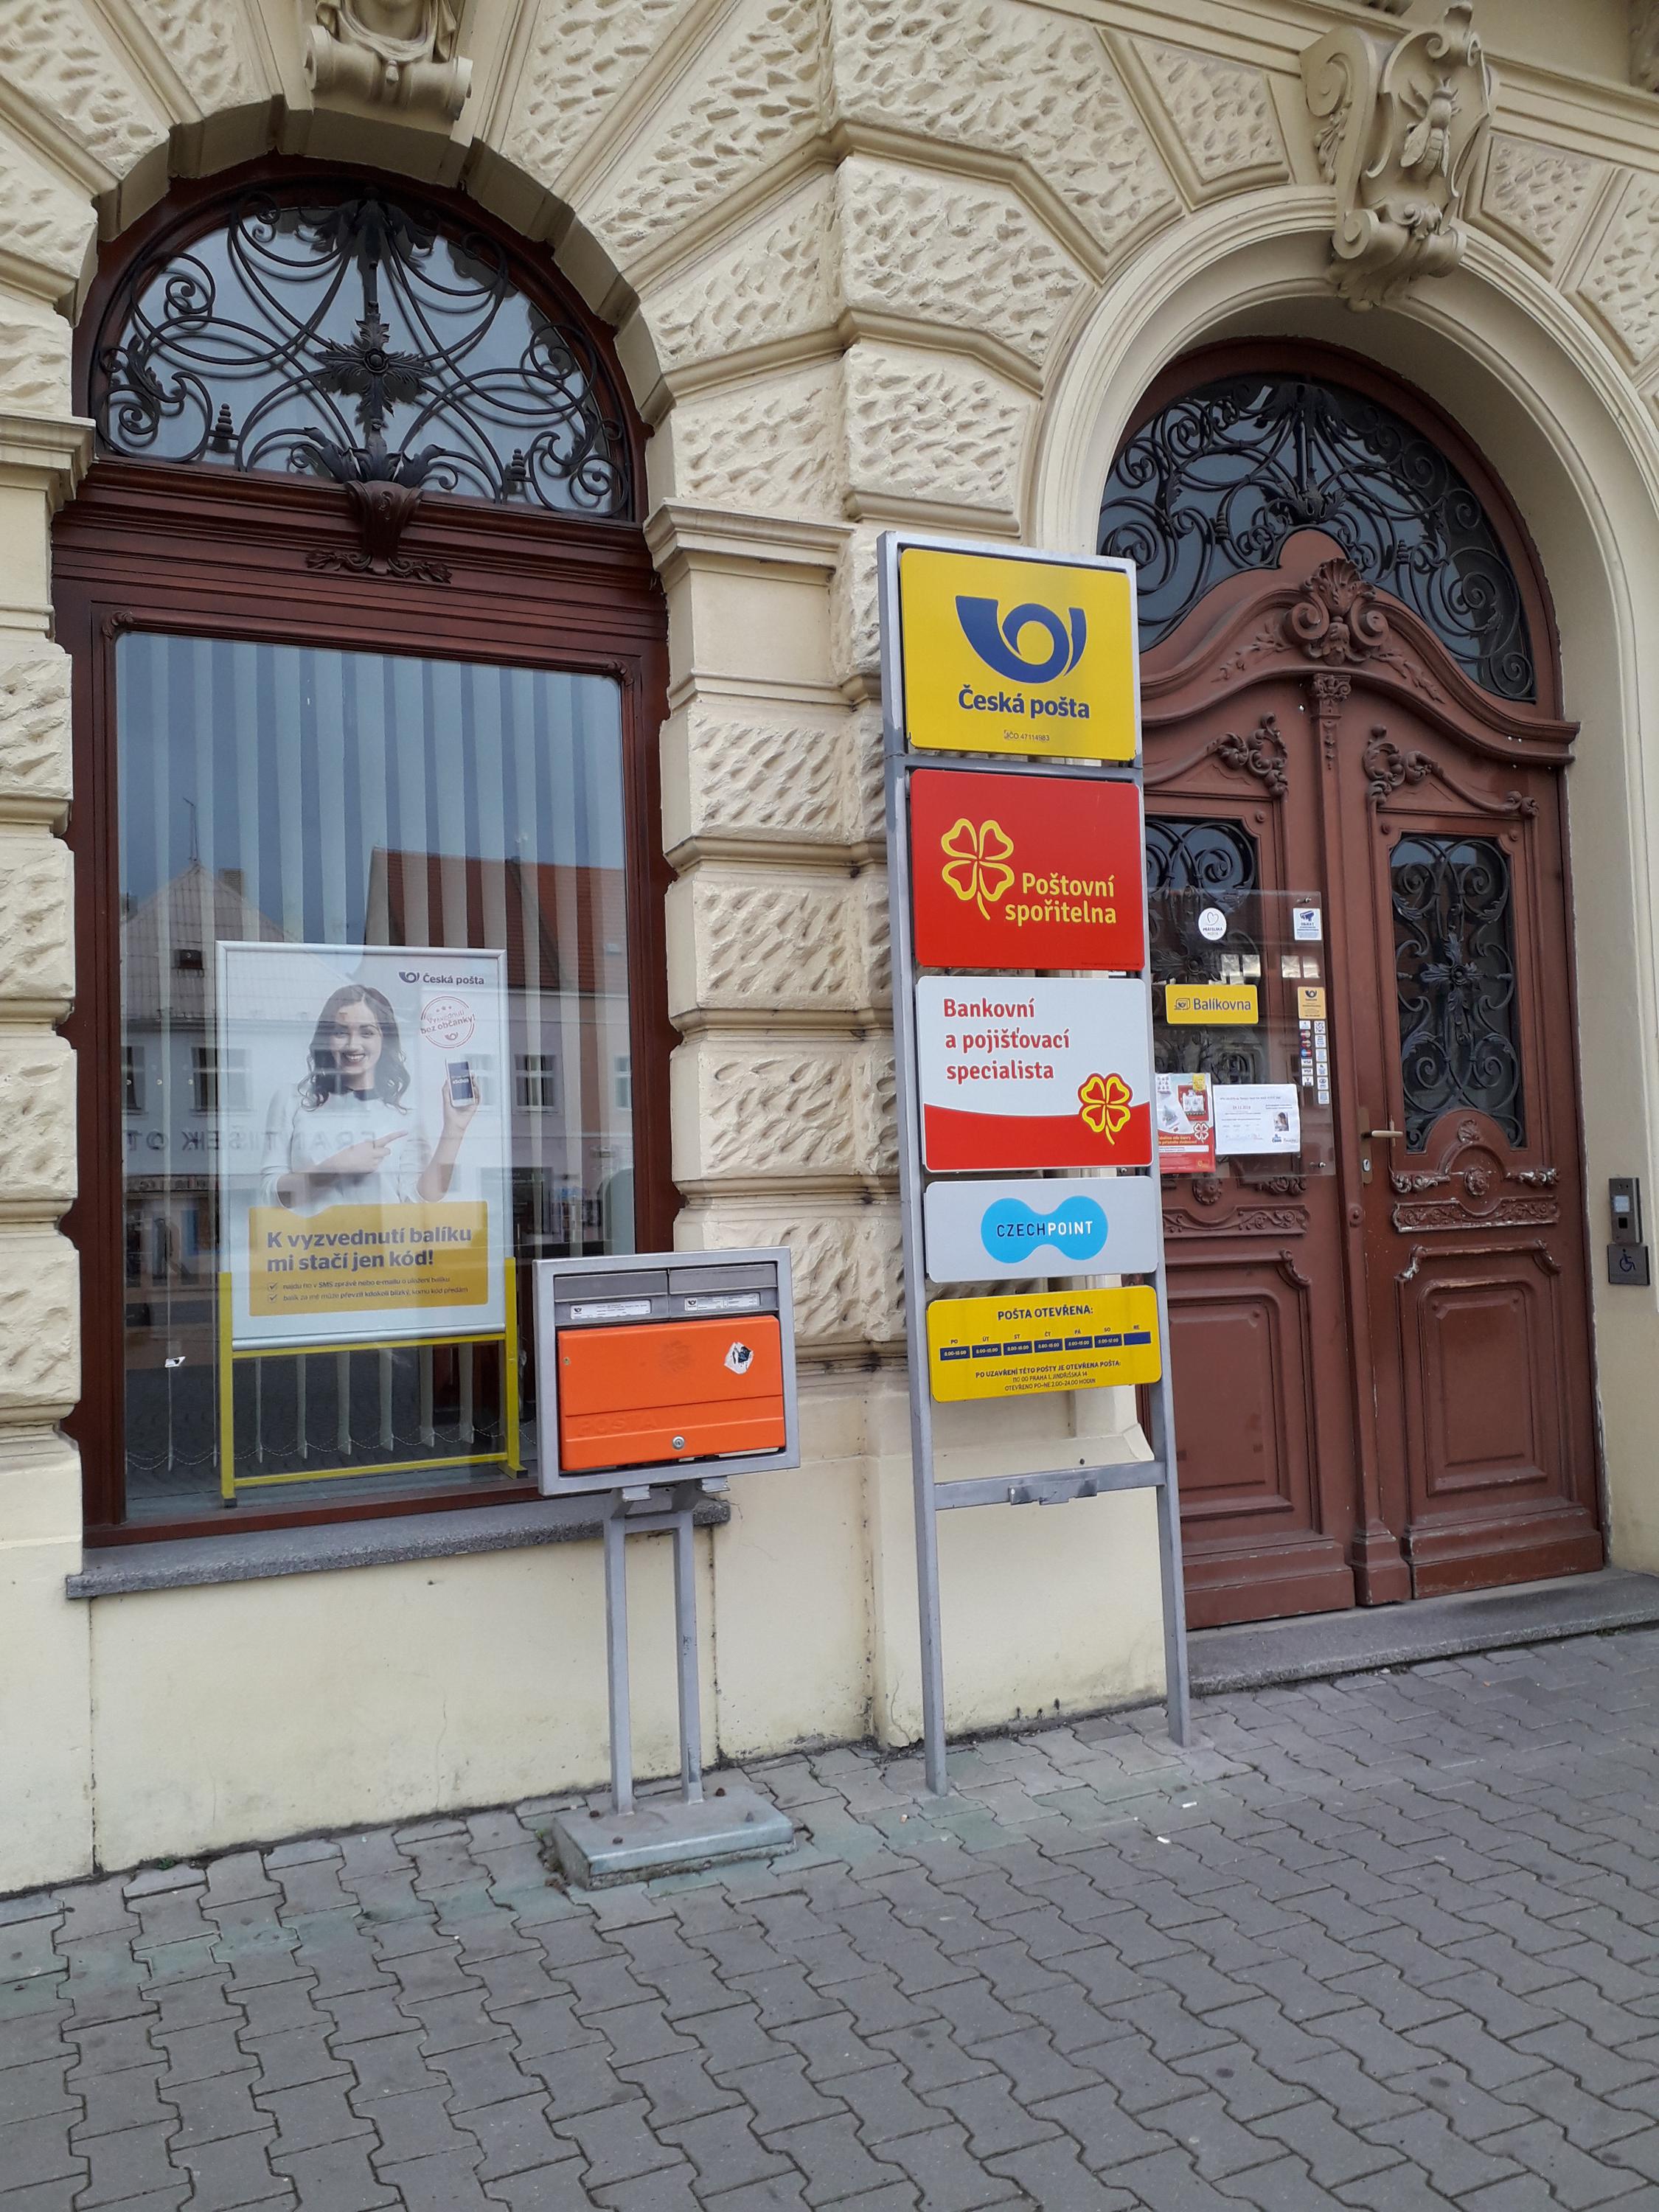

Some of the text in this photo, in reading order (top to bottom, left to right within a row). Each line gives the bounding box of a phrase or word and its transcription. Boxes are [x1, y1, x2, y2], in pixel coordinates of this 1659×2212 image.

[959, 684, 1090, 719] Česká pošta
[1022, 872, 1115, 897] Poštovní
[1005, 899, 1116, 926] spořitelna
[422, 973, 484, 985] Česká pošta
[943, 998, 1035, 1018] Bankovní
[1193, 998, 1251, 1011] Balíkovna
[420, 1025, 437, 1034] bez
[945, 1027, 1070, 1054] a pojišťovací
[947, 1060, 1054, 1085] specialista
[268, 1226, 472, 1251] K vyzvednutí balíku
[268, 1249, 434, 1272] mi stačí jen kód!
[335, 1280, 356, 1290] zprávě
[998, 1304, 1093, 1321] POŠTA OTEVŘENA:
[986, 1367, 1018, 1377] UZAVŘENÍ
[1036, 1365, 1057, 1373] POŠTY
[1066, 1361, 1099, 1370] OTEVŘENA
[1005, 1383, 1033, 1391] OTEVŘENO
